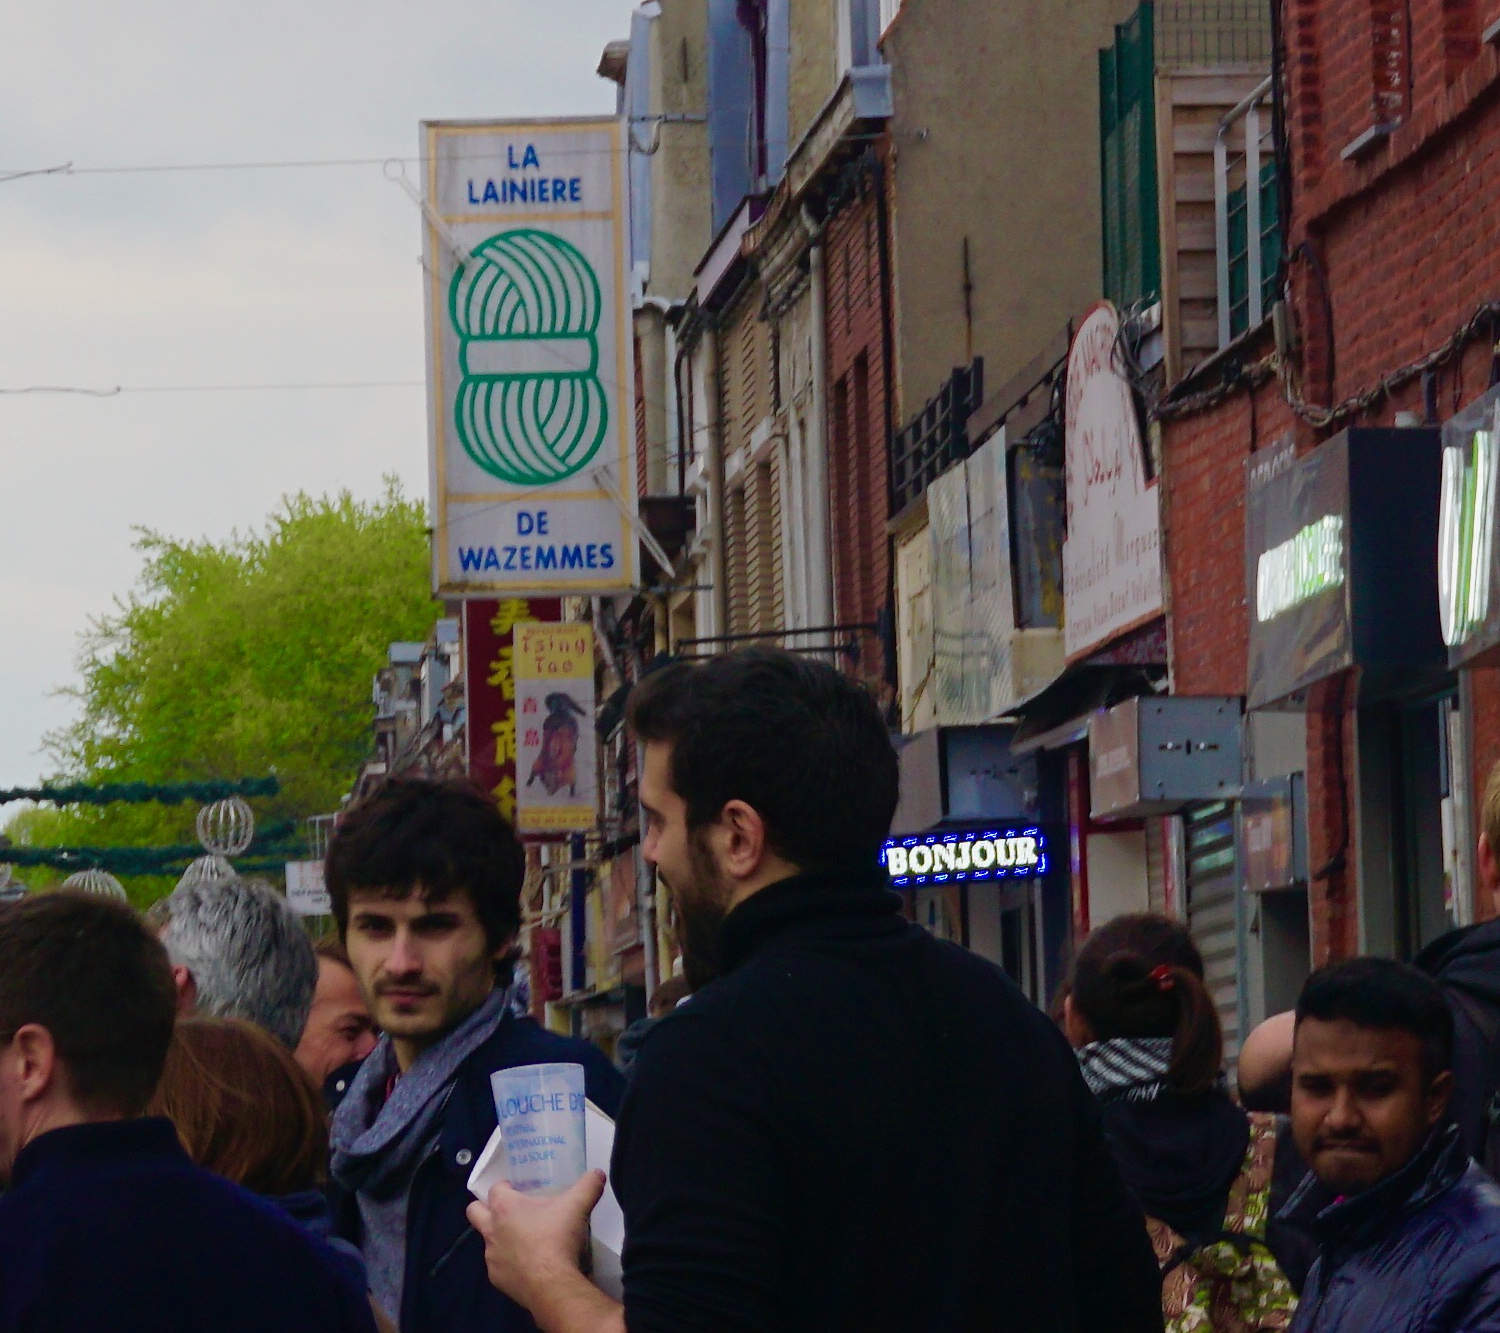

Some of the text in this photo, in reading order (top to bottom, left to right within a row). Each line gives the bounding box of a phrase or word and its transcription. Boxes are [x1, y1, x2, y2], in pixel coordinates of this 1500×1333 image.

[508, 143, 540, 169] LA
[467, 177, 583, 204] LAINIERE
[516, 510, 549, 536] DE
[458, 543, 615, 573] WAZEMMES
[884, 835, 1038, 878] BONJOUR
[499, 1092, 565, 1119] LOUCHE
